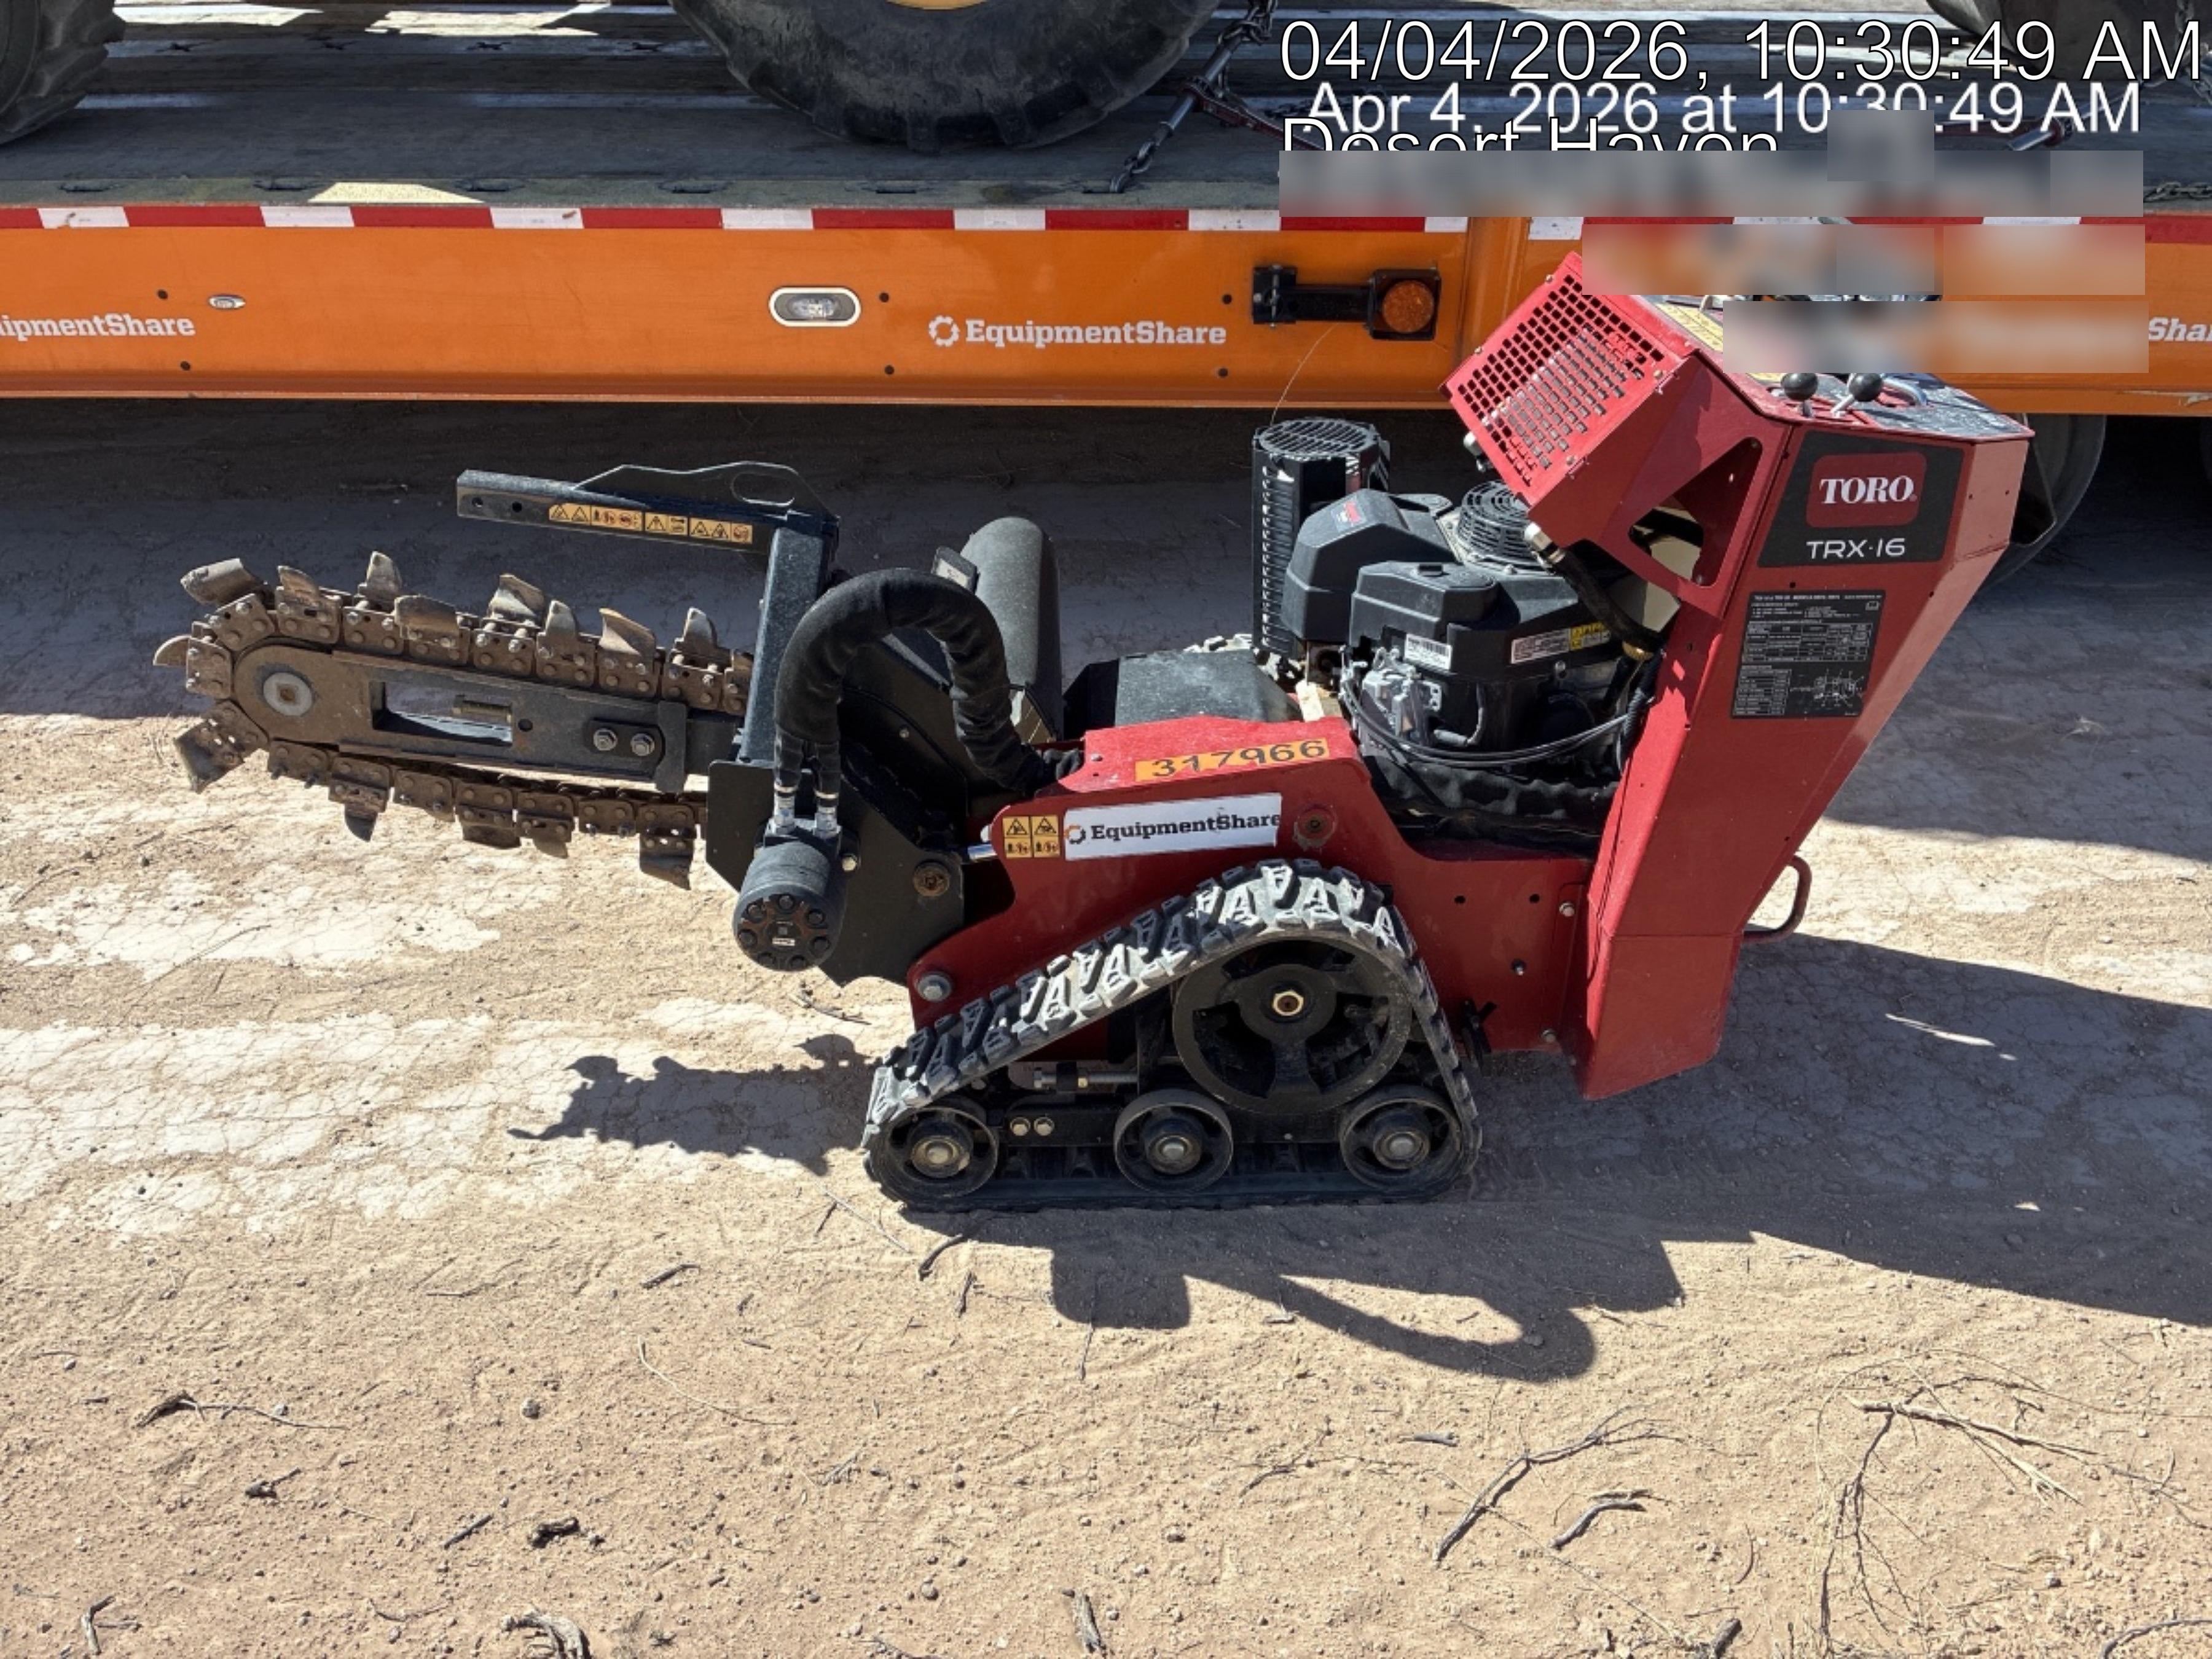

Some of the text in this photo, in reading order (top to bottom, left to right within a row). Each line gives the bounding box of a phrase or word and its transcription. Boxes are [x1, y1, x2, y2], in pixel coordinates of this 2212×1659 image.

[965, 318, 1226, 348] EquipmentShare
[1819, 475, 1915, 504] TORO
[1151, 740, 1327, 777] 317966
